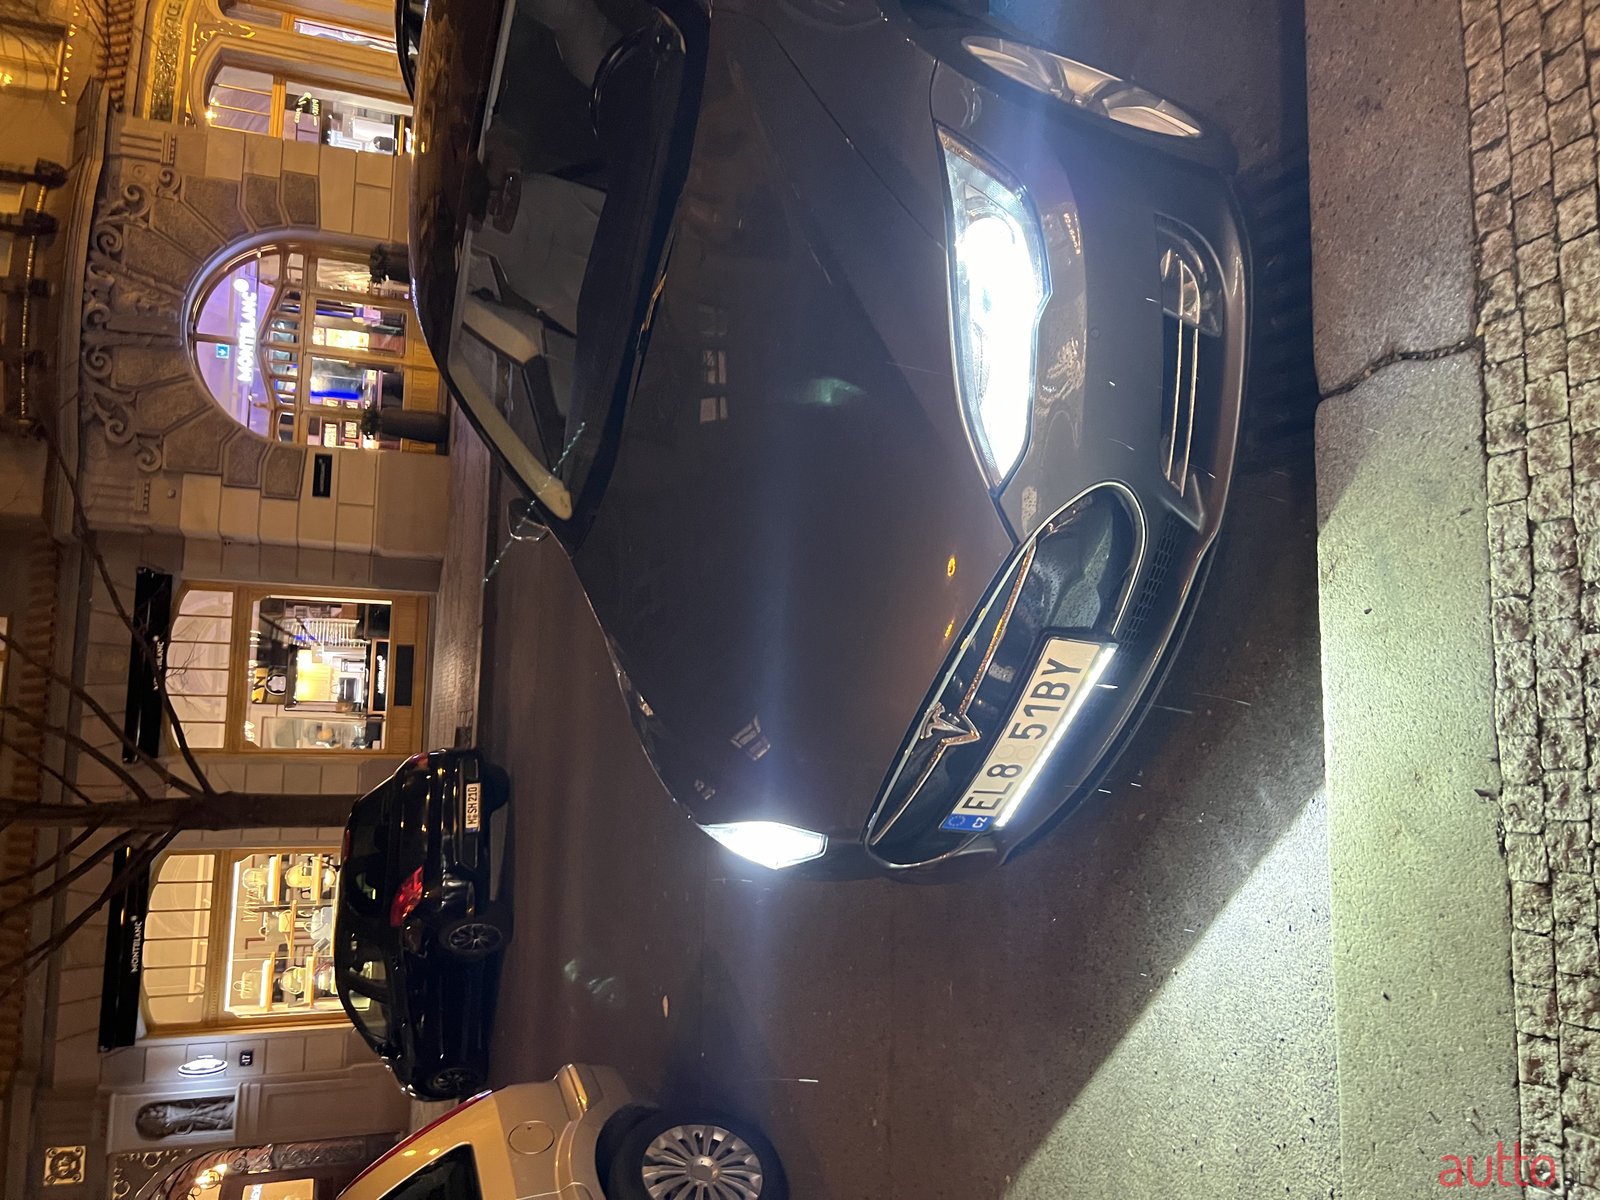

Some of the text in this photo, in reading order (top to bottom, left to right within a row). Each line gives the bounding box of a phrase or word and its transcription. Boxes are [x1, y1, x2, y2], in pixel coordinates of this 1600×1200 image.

[237, 291, 257, 382] MONTBLANC
[971, 816, 988, 829] CZ
[130, 921, 142, 973] MONTBLANC
